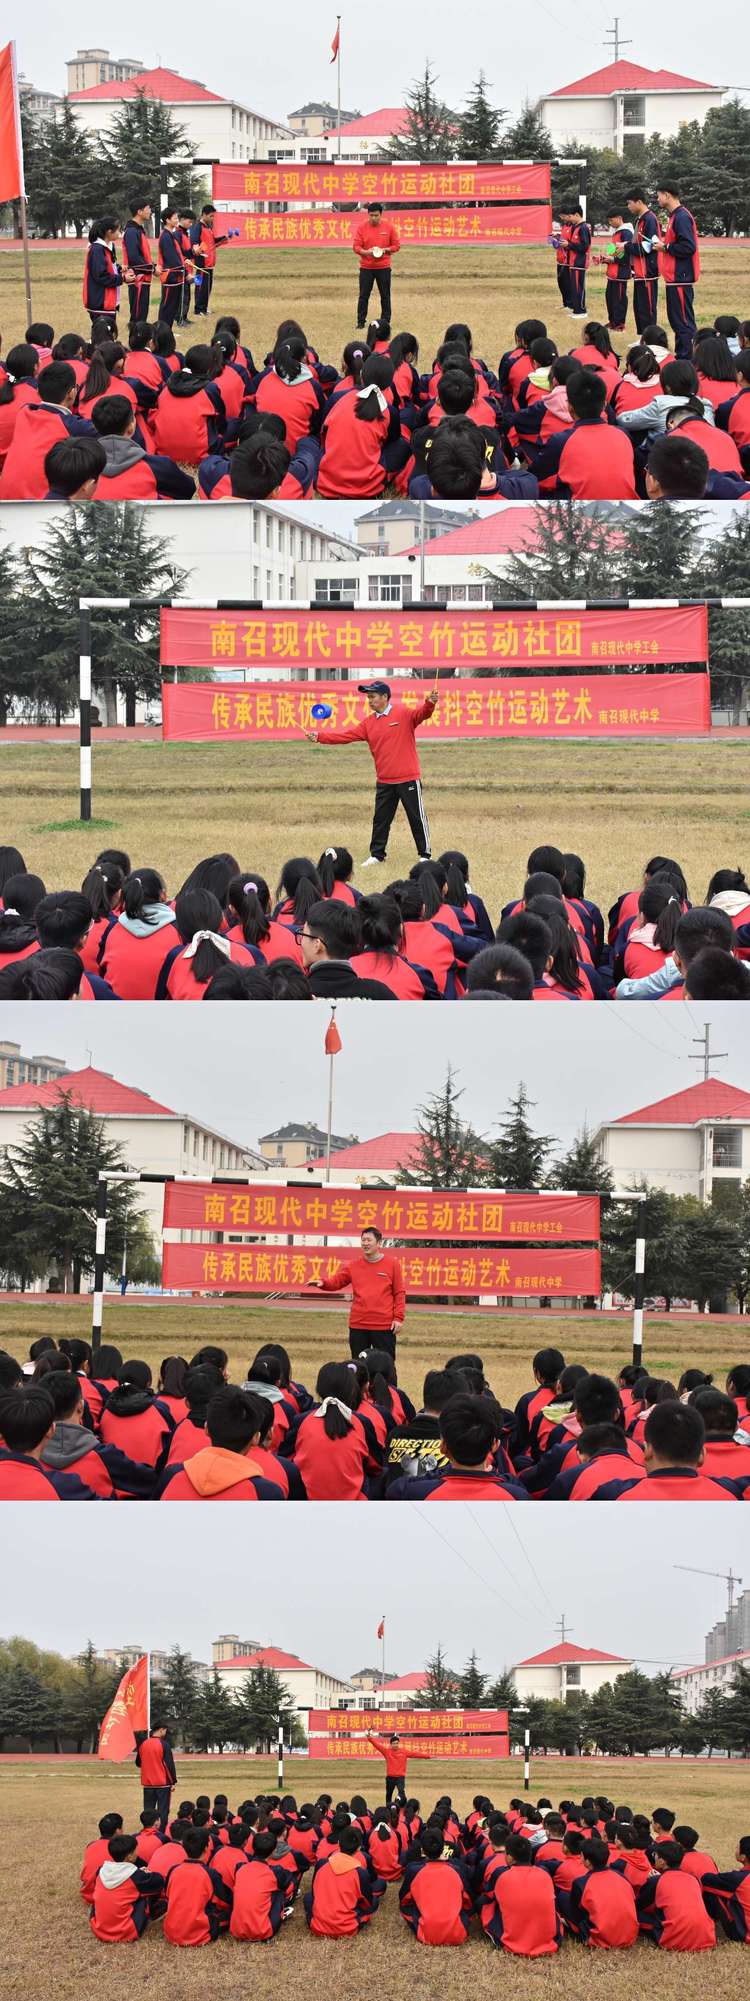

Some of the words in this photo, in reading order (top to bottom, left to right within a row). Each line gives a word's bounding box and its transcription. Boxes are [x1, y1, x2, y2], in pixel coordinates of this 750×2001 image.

[244, 171, 475, 197] 南召现代中学空竹运动社团
[244, 217, 352, 241] 传承民族优秀文化
[209, 620, 582, 658] 南召现代中学空竹运动社团
[591, 640, 659, 656] 南召现代中学工会
[598, 708, 660, 725] 南召现代中学
[203, 1194, 505, 1233] 南召现代中学空竹运动社团
[509, 1221, 563, 1234] 南召现代中学工会
[202, 1251, 342, 1284] 传承民族优秀文化
[514, 1276, 563, 1289] 南召现代中学
[327, 1713, 464, 1730] 南召现代中学空竹运动社团
